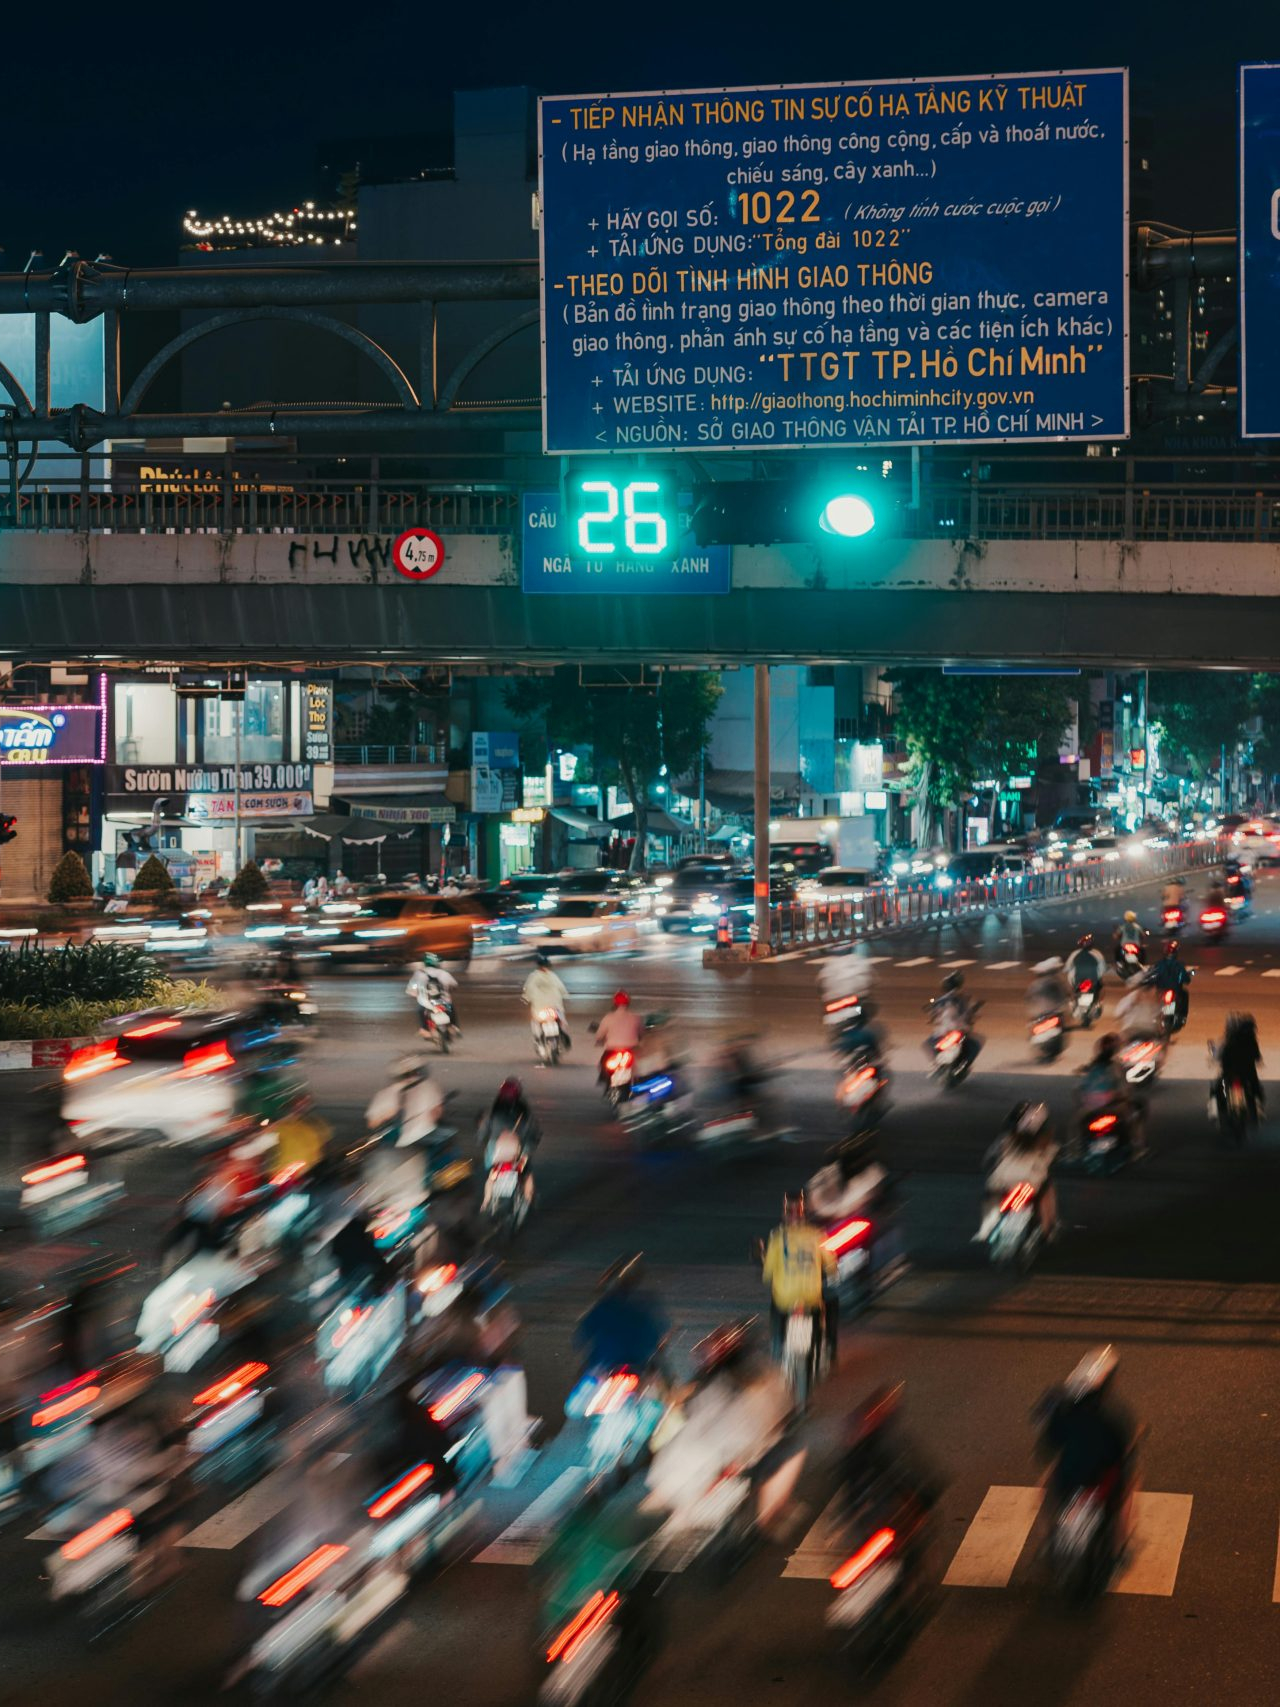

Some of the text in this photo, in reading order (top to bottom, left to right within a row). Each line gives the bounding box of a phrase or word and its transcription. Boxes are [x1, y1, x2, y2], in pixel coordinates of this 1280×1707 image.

[571, 99, 614, 130] TIẾP
[623, 101, 683, 129] NHẬN
[692, 98, 764, 124] THÔNG
[771, 99, 804, 120] TIN
[811, 95, 840, 122] SỰ
[845, 87, 872, 117] CỐ
[880, 94, 909, 119] HẠ
[915, 88, 970, 114] TẦNG
[980, 84, 1007, 111] KỸ
[1018, 82, 1086, 110] THUẬT
[603, 139, 638, 163] tầng
[646, 141, 678, 162] giao
[685, 140, 737, 159] thông,
[743, 140, 777, 158] giao
[784, 135, 831, 154] thông
[839, 133, 879, 153] công
[888, 130, 936, 151] cộng,
[941, 122, 971, 148] cấp
[979, 125, 998, 143] và
[1006, 122, 1049, 142] thoát
[1056, 119, 1104, 139] nước,
[727, 162, 772, 184] chiếu
[782, 164, 828, 185] sáng,
[834, 161, 866, 183] cây
[608, 208, 642, 229] HÃY
[648, 211, 677, 233] GỌI
[687, 201, 717, 226] SỐ:
[738, 190, 820, 224] 1022
[909, 197, 940, 218] tính
[944, 196, 982, 216] cước
[986, 197, 1022, 218] cuộc
[609, 233, 636, 256] TẢI
[645, 233, 683, 255] ỨNG
[816, 231, 840, 249] đài
[633, 267, 667, 294] DÕI
[676, 266, 727, 292] TÌNH
[738, 263, 788, 290] HÌNH
[798, 265, 848, 288] GIAO
[857, 259, 932, 286] THÔNG
[615, 298, 636, 321] đồ
[642, 301, 674, 320] tình
[682, 302, 731, 323] trạng
[739, 303, 776, 322] giao
[783, 298, 835, 319] thông
[843, 295, 883, 313] theo
[890, 293, 925, 312] thời
[932, 293, 970, 315] gian
[978, 290, 1025, 312] thực,
[1033, 290, 1108, 308] camera
[573, 334, 608, 356] giao
[616, 332, 673, 353] thông,
[681, 327, 724, 352] phản
[734, 328, 766, 346] ánh
[774, 330, 797, 349] sự
[804, 322, 827, 344] cố
[832, 325, 852, 343] hạ
[860, 319, 898, 346] tầng
[908, 321, 929, 340] và
[938, 320, 971, 339] các
[980, 321, 1014, 342] tiện
[1021, 315, 1048, 337] ích
[613, 363, 638, 386] TẢI
[647, 363, 685, 385] ỨNG
[695, 366, 752, 387] DỤNG:
[968, 348, 1013, 376] Chí
[712, 389, 1034, 416] http://giaothong.hochiminhcity.gov.vn
[616, 416, 688, 443] NGUỒN:
[699, 417, 722, 440] SỞ
[732, 422, 774, 439] GIAO
[783, 416, 847, 438] THÔNG
[853, 415, 891, 440] VẬN
[898, 411, 924, 434] TẢI
[932, 417, 956, 433] TP.
[964, 412, 990, 433] HỒ
[998, 409, 1030, 432] CHÍ
[1037, 413, 1083, 431] MINH
[528, 506, 557, 528] CẦU
[578, 482, 668, 554] 26
[671, 558, 710, 574] XANH
[125, 768, 172, 792] Sườn
